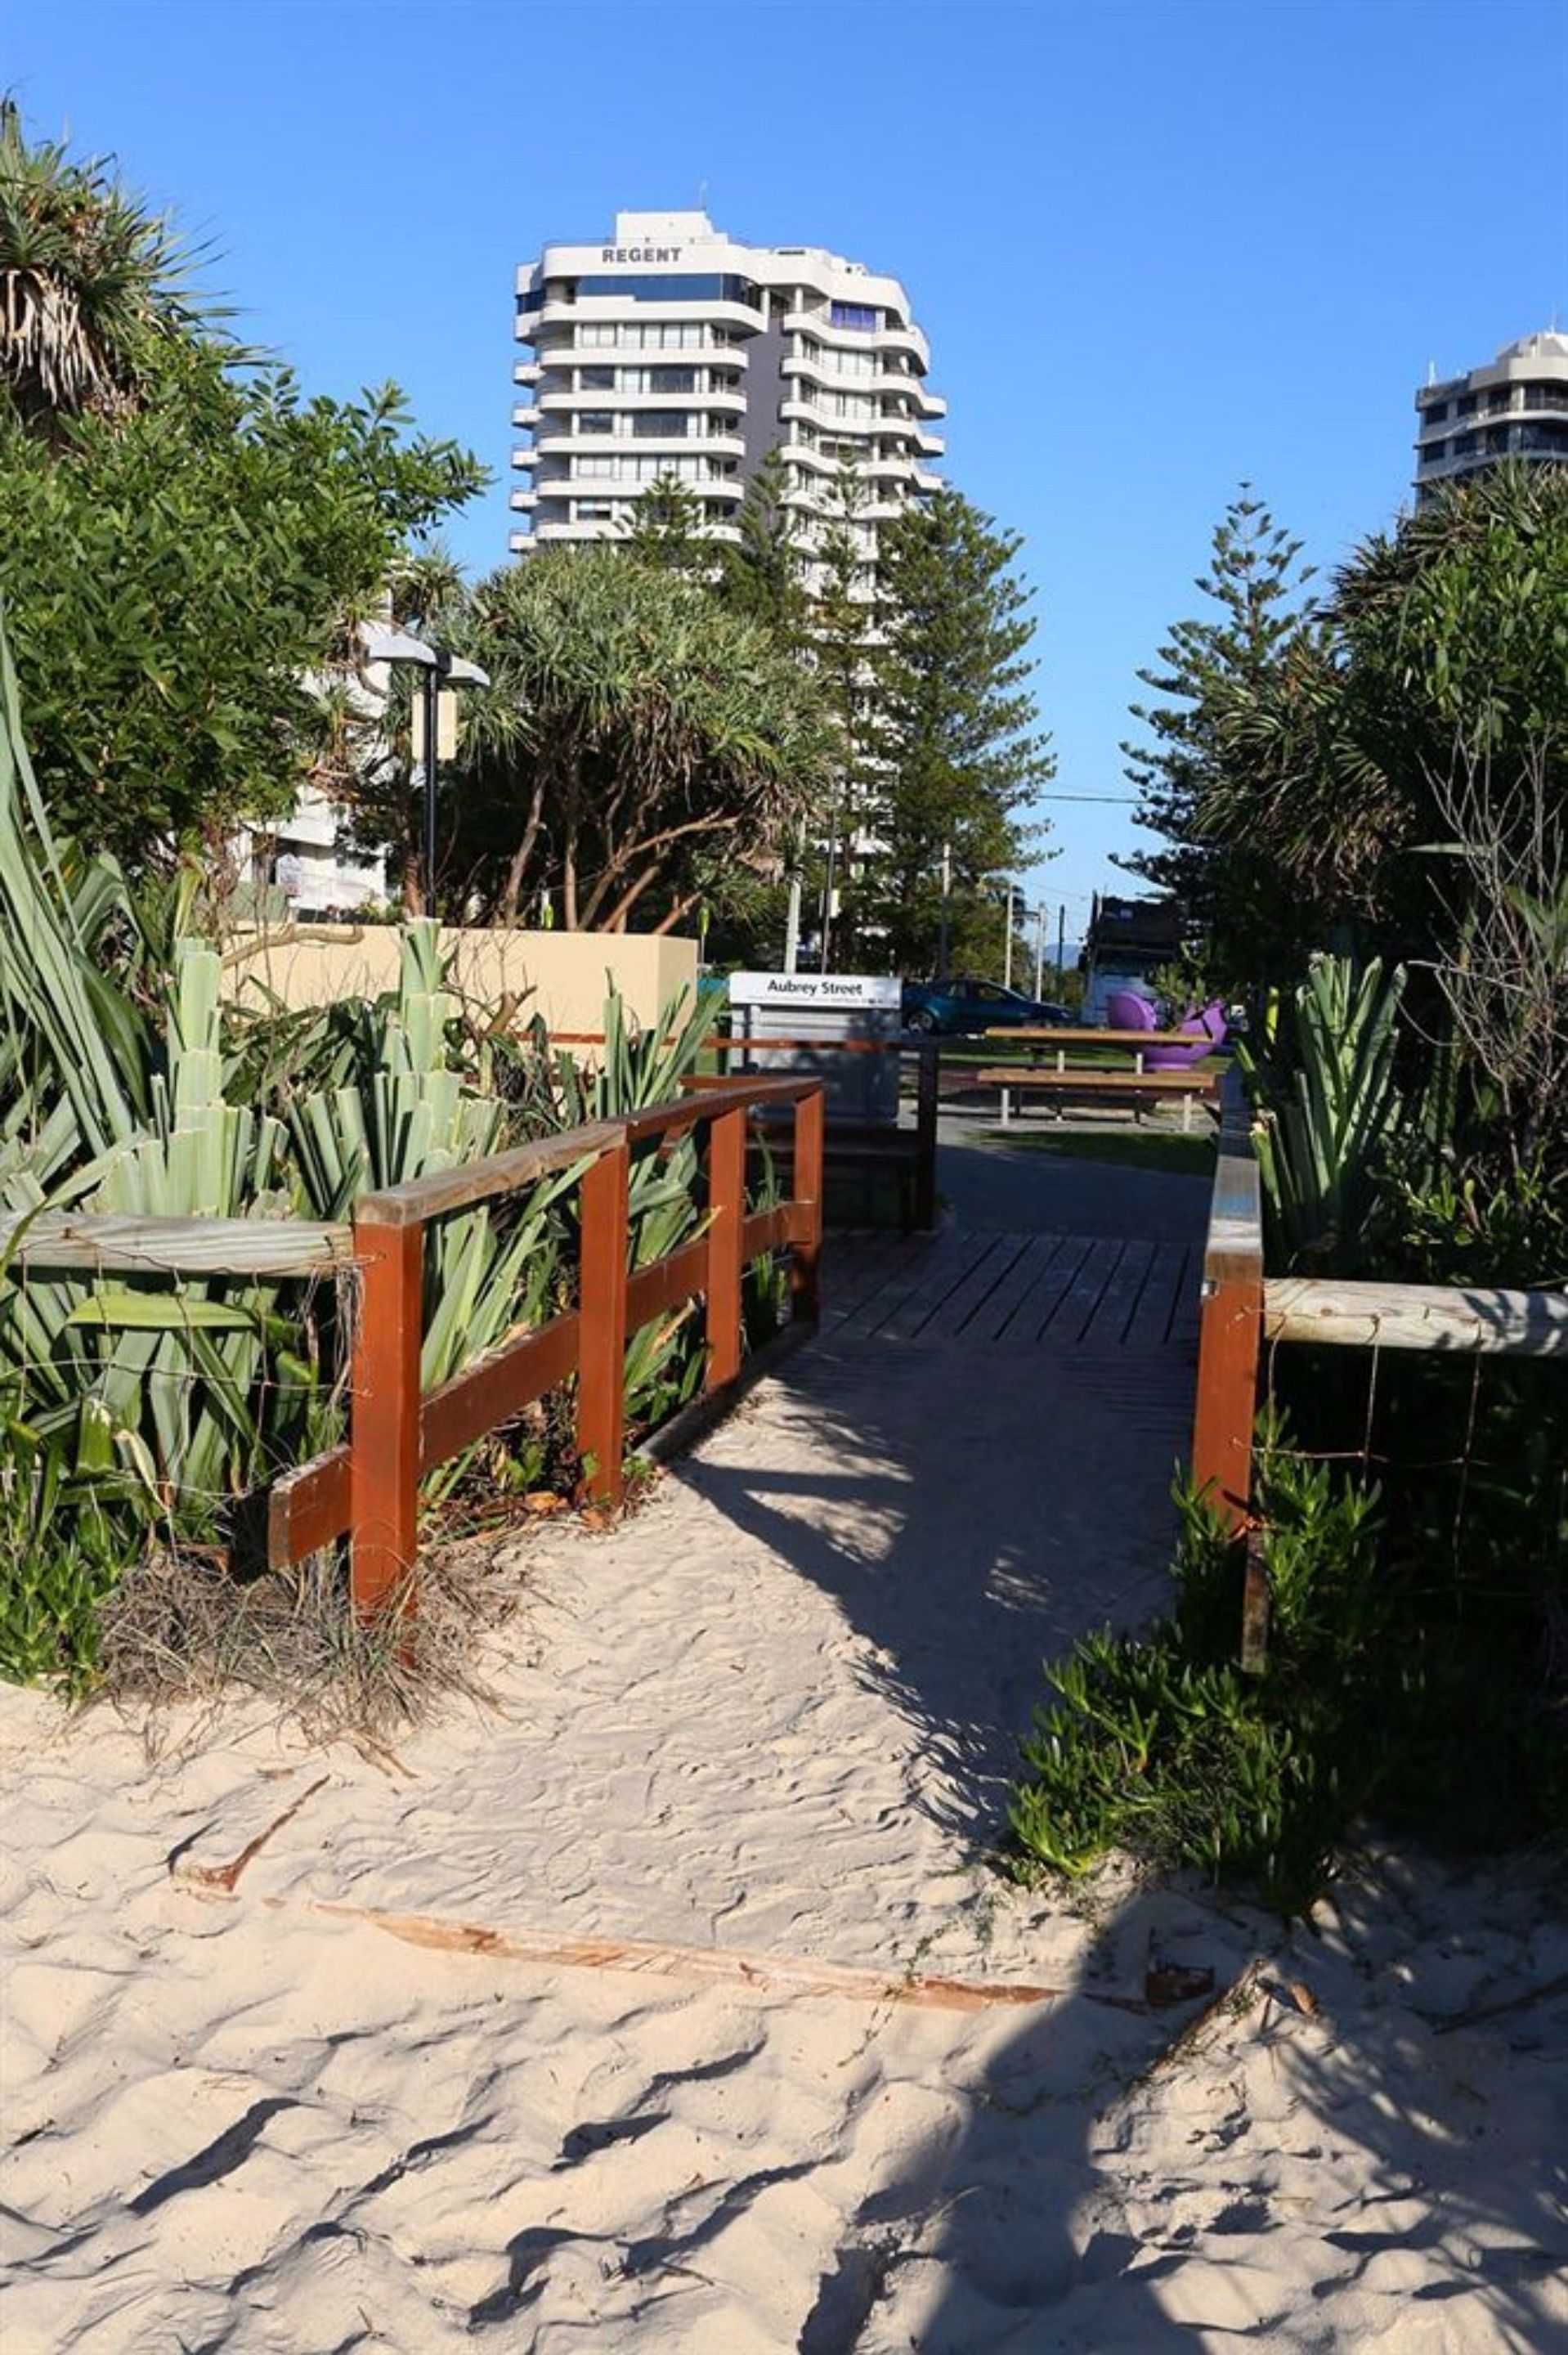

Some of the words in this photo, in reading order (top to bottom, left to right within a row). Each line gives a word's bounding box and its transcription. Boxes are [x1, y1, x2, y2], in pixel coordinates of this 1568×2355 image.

[602, 247, 682, 262] REGENT
[767, 980, 818, 995] Aubrey
[821, 981, 862, 994] Street
